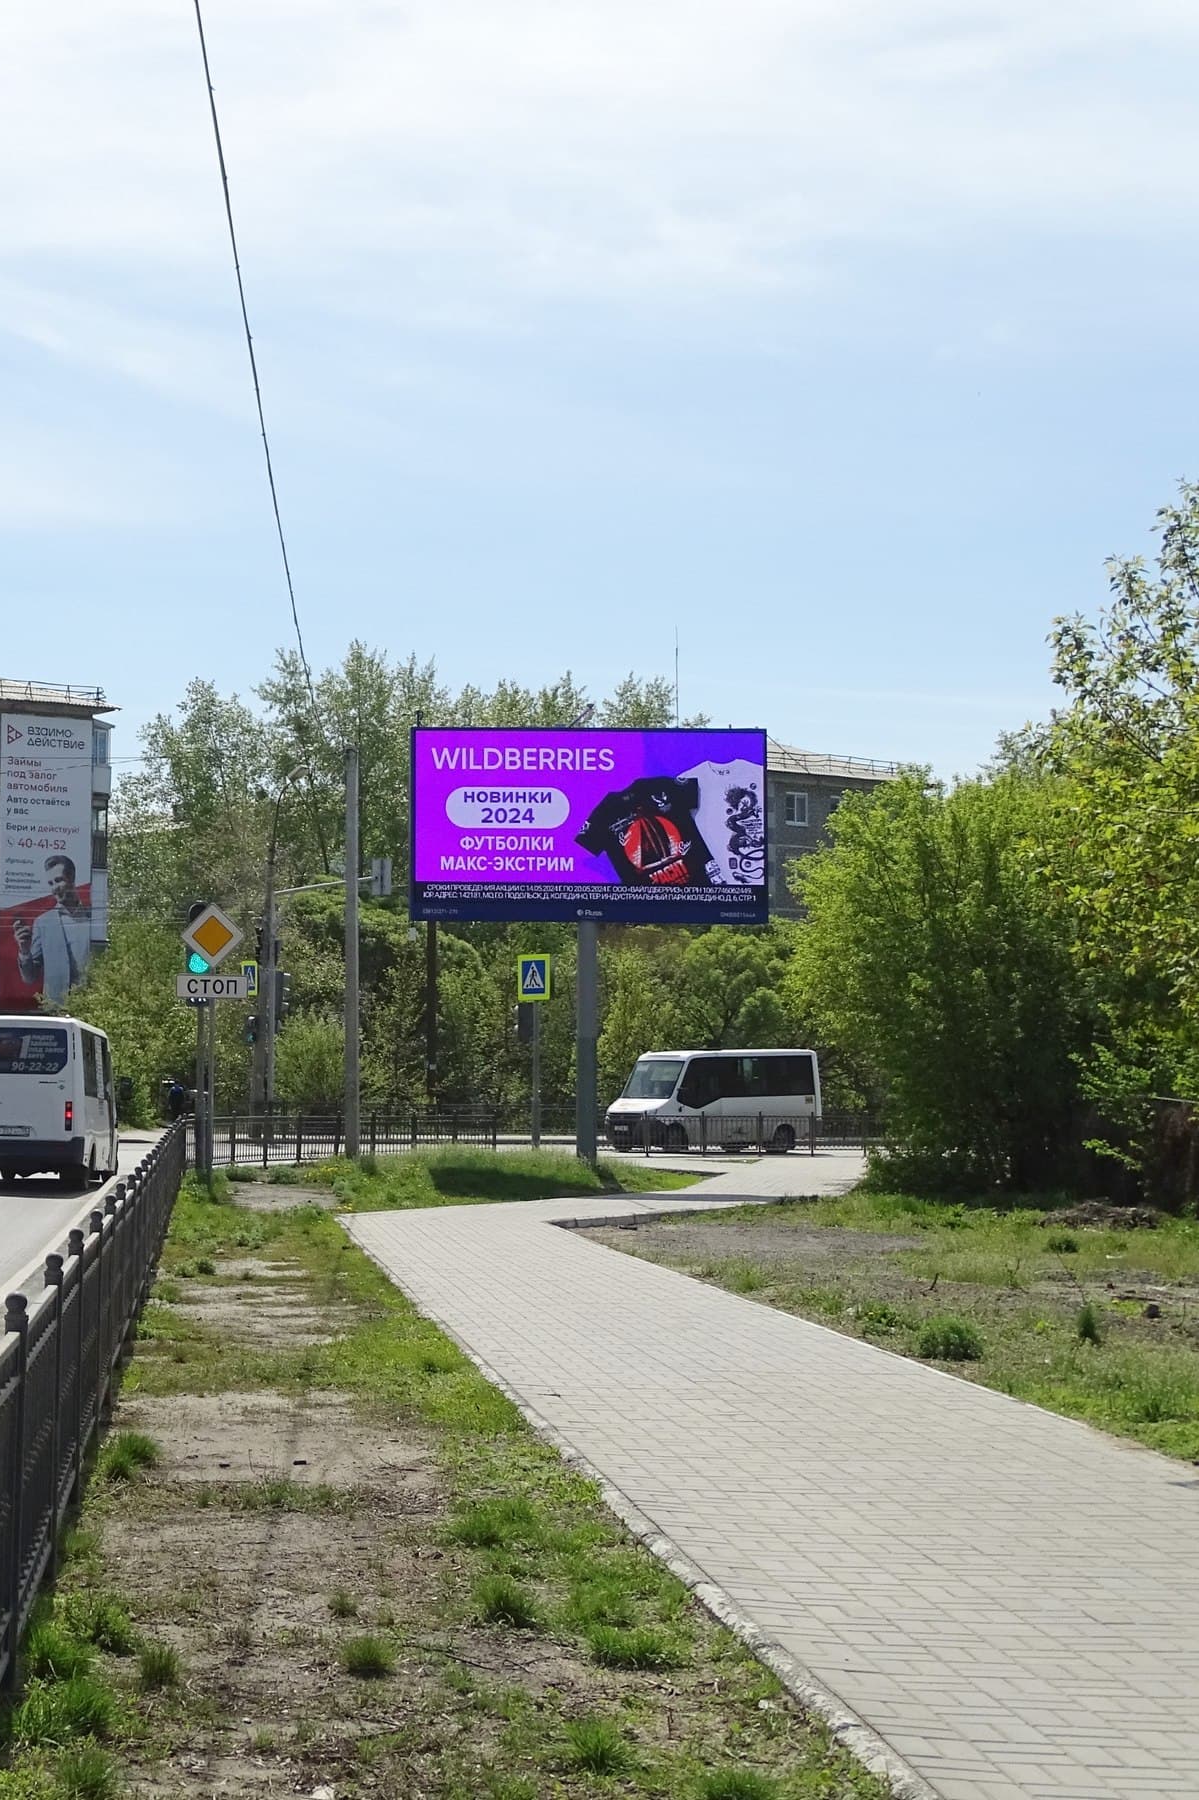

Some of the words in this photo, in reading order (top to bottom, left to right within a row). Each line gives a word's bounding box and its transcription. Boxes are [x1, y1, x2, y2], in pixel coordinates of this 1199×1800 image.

[7, 756, 42, 767] Займы
[431, 747, 615, 771] WILDBERRIES
[7, 770, 26, 779] под
[28, 771, 57, 780] залог
[6, 782, 68, 793] автомобиля
[6, 794, 28, 805] Авто
[463, 791, 552, 804] НОВИНКИ
[6, 807, 12, 816] у
[13, 807, 29, 815] вас
[480, 808, 535, 824] 2024
[6, 822, 28, 832] Бери
[17, 838, 67, 850] 40-41-52
[459, 835, 554, 851] ФУТБОЛКИ
[440, 855, 574, 872] МАКС-ЭКСТРИМ
[187, 978, 237, 995] СТОП
[11, 1062, 59, 1072] 90-22-22
